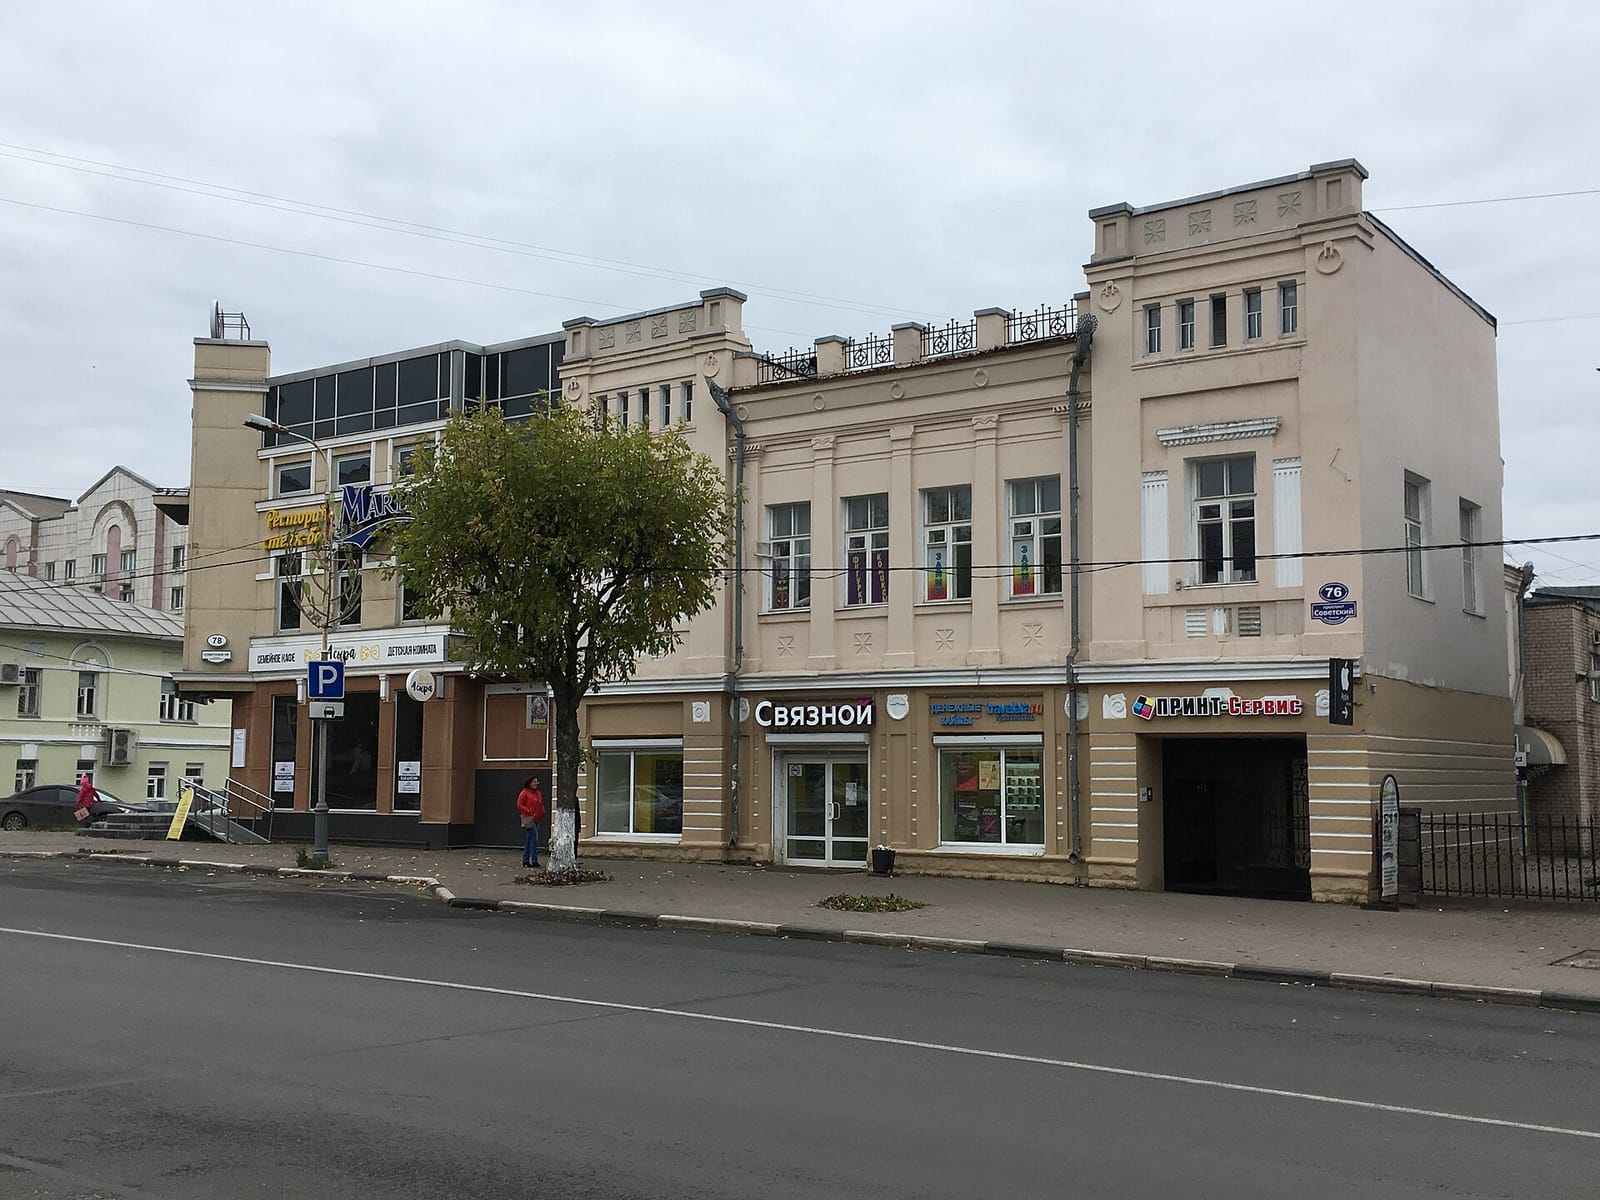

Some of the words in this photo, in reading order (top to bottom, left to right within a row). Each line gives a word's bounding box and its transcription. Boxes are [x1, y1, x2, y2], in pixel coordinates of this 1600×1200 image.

[1324, 586, 1343, 598] 76
[1314, 607, 1354, 617] Советский
[212, 637, 223, 645] 78
[387, 645, 412, 657] ДЕТСКАЯ
[412, 643, 438, 655] КОМНАТА
[257, 653, 281, 665] СЕМЕЙНОЕ
[281, 652, 296, 663] КАФЕ
[930, 703, 982, 715] ДЕНЕЖНЫЕ
